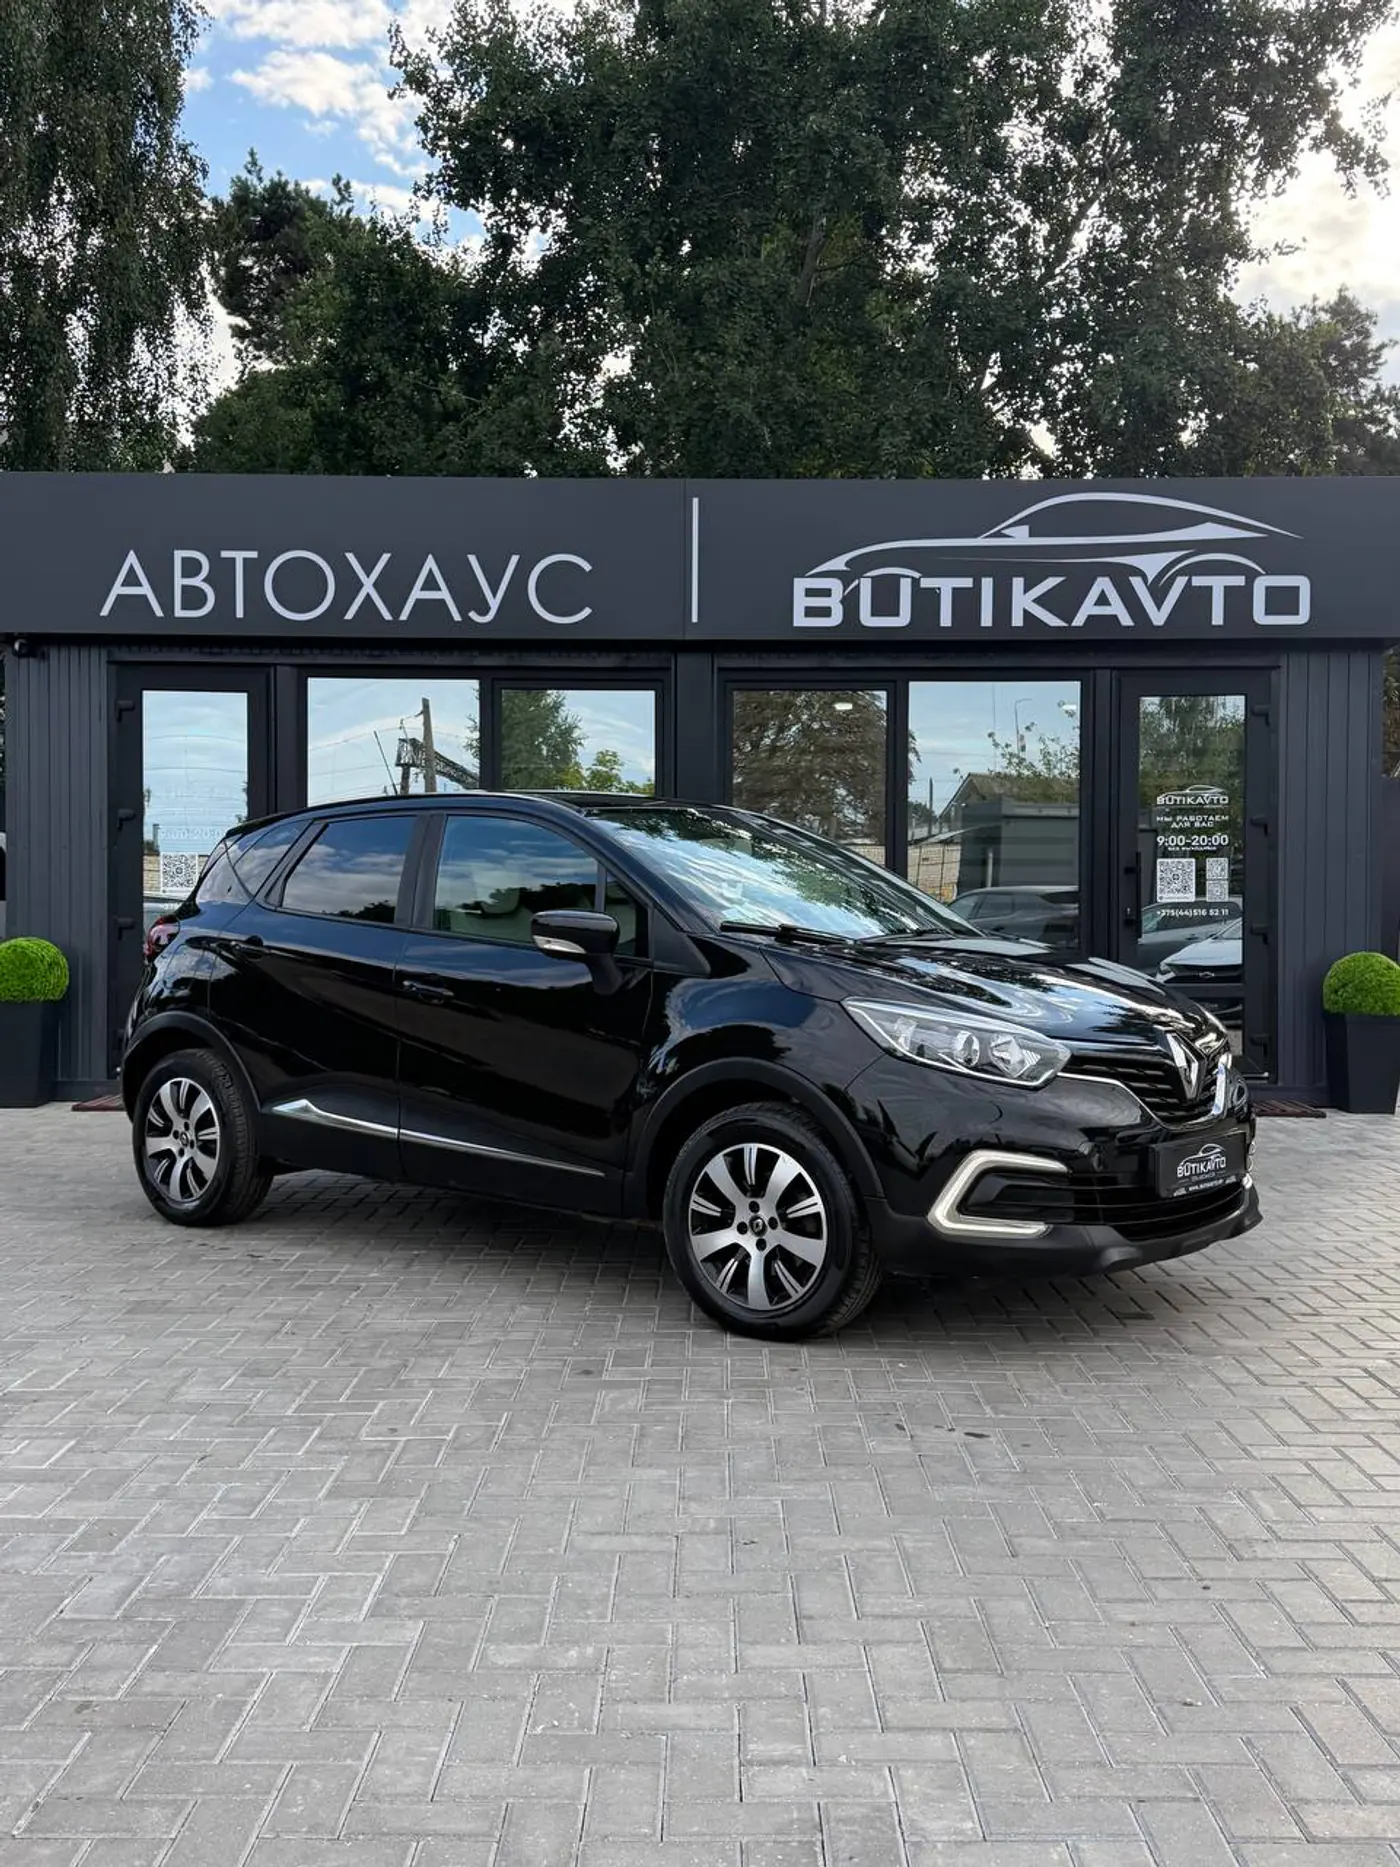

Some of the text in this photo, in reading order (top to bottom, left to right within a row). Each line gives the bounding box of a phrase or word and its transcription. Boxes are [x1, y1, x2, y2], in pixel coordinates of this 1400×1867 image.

[99, 549, 593, 625] АВТОХАУС
[792, 574, 1311, 627] BUTIKAVTO
[1156, 796, 1229, 805] BUTIKAVTO
[1156, 835, 1229, 846] 9:00-20:00
[1177, 1157, 1227, 1177] BUTIKAVTO
